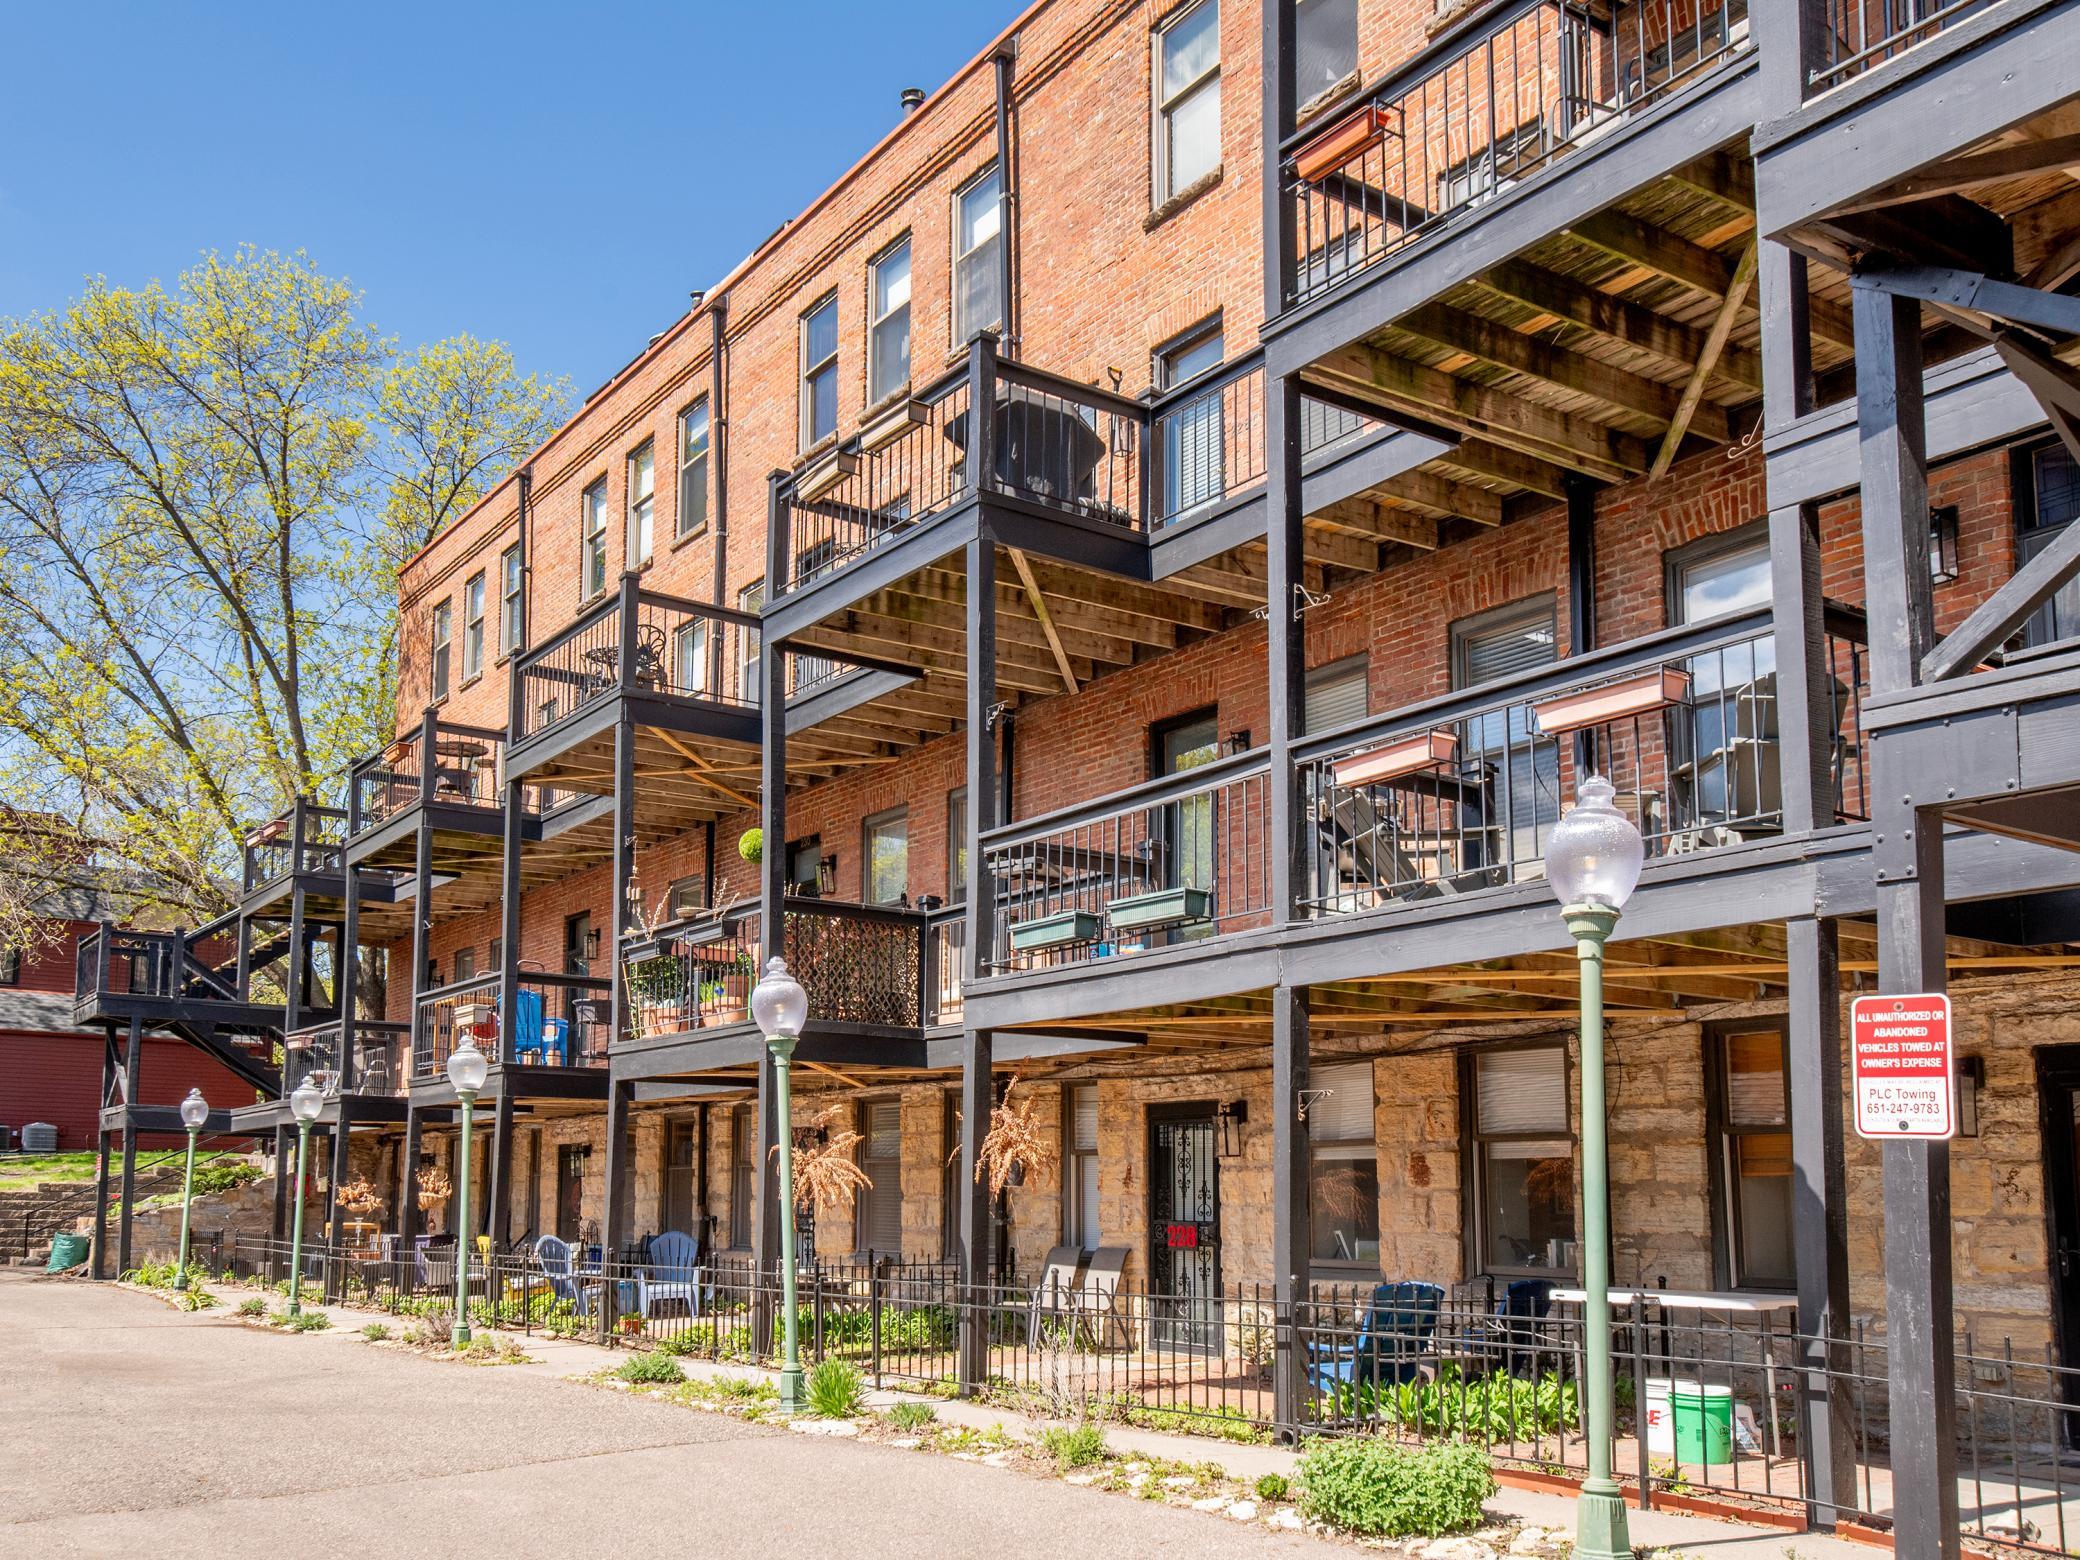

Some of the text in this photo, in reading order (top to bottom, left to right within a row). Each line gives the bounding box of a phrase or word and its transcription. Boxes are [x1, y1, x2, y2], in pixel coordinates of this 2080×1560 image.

[1857, 1011, 1944, 1023] ALL UNAUTHORIZED OR
[1873, 1027, 1928, 1037] ABANDONED
[1858, 1042, 1944, 1053] VEHICLES TOWED AT
[1861, 1058, 1943, 1068] OWNER'S EXPENSE
[1869, 1088, 1936, 1101] PLC Towing
[1867, 1103, 1940, 1114] 651-247-9783
[1167, 1224, 1197, 1248] 228
